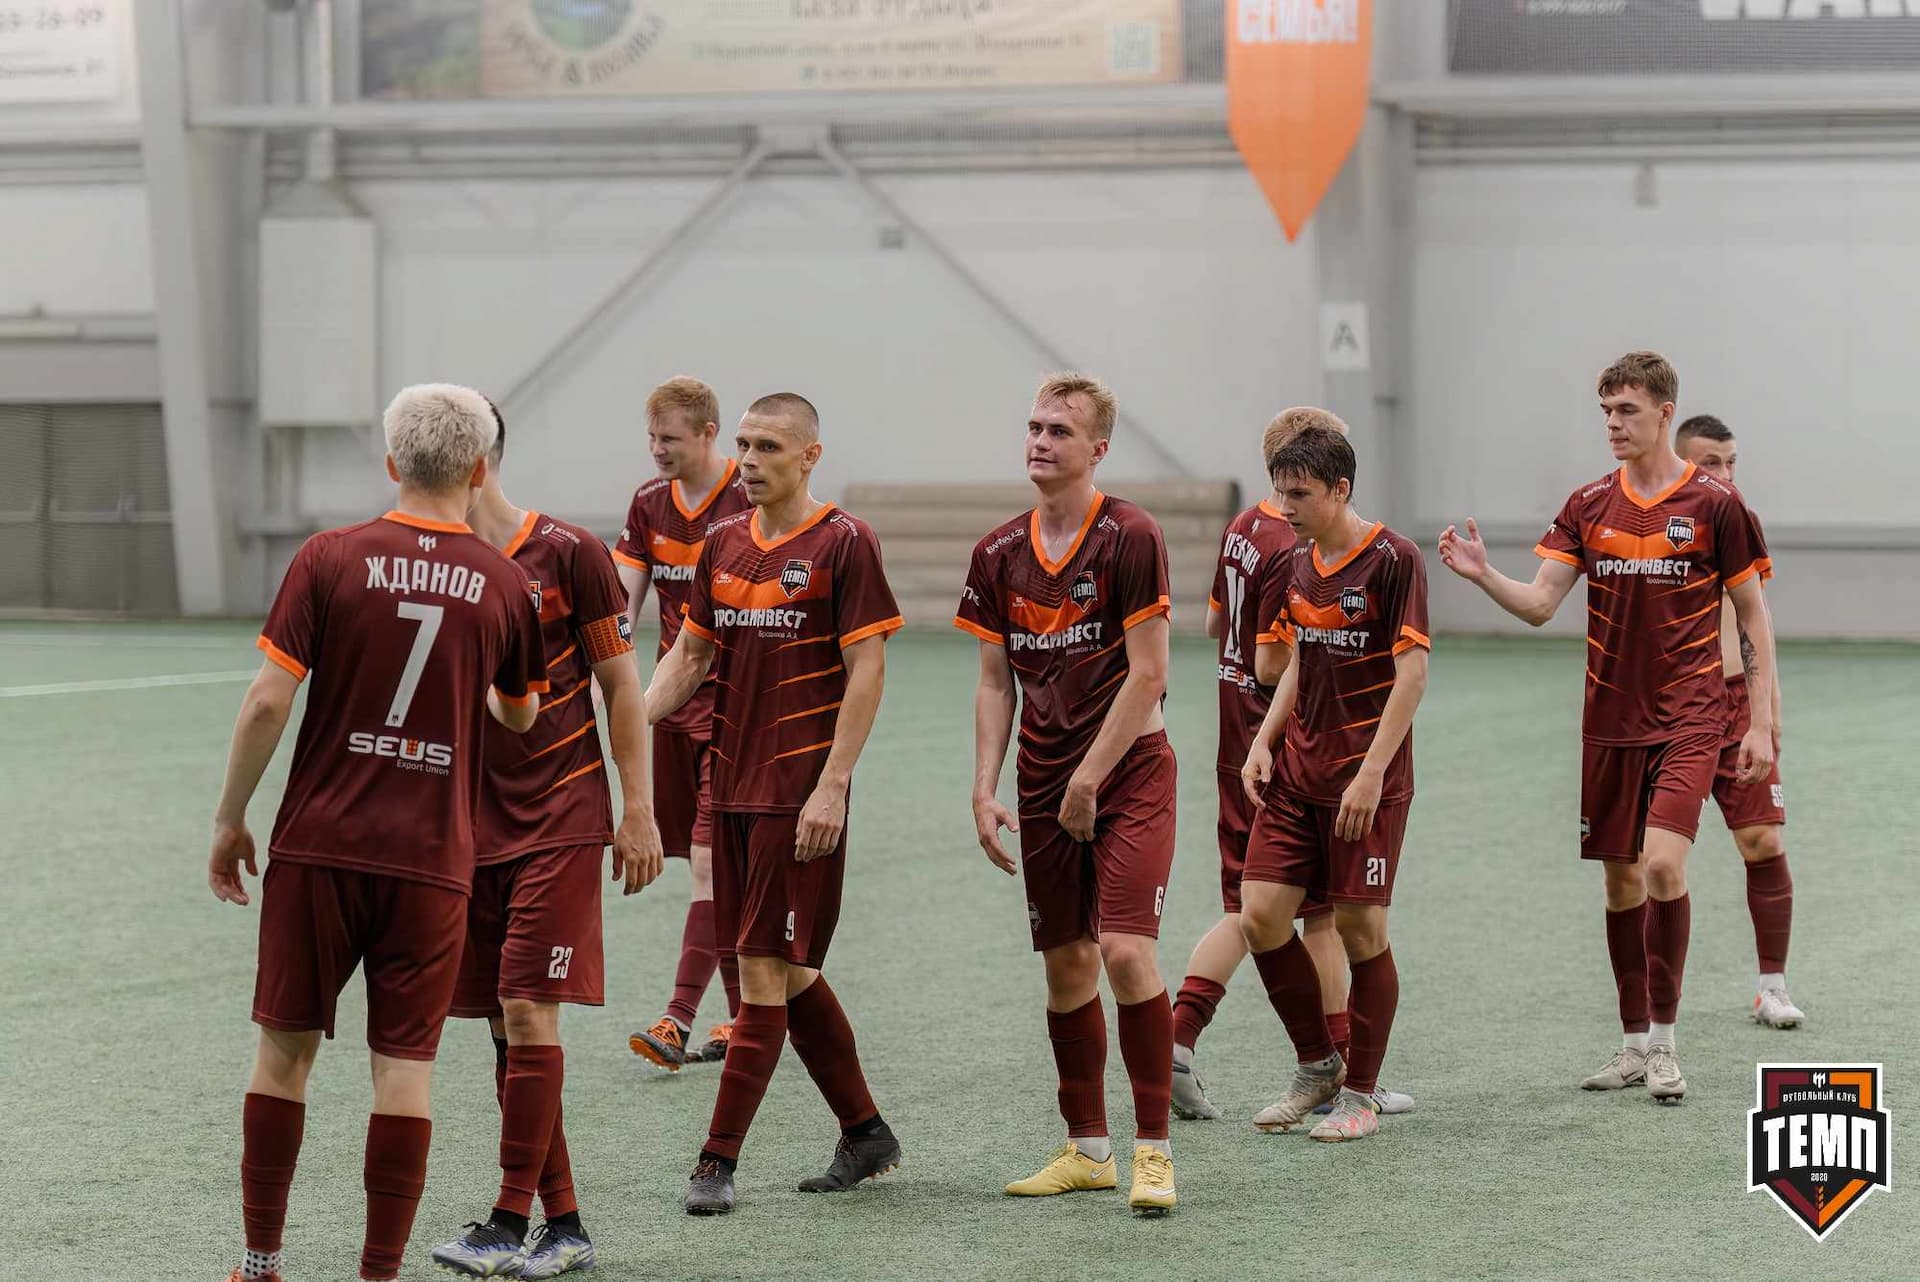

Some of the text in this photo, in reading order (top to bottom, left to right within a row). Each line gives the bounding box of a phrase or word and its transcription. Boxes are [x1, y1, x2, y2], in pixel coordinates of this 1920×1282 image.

[364, 556, 486, 605] ЖДАНОВ
[782, 570, 809, 585] ТЕМП
[1595, 558, 1692, 578] ПРОДИНВЕСТ
[384, 601, 445, 729] 7
[348, 731, 454, 766] SEUS
[396, 758, 450, 776] Export Union
[1366, 857, 1387, 886] 21
[1154, 885, 1164, 917] 6
[785, 910, 795, 942] 9
[547, 945, 574, 980] 23
